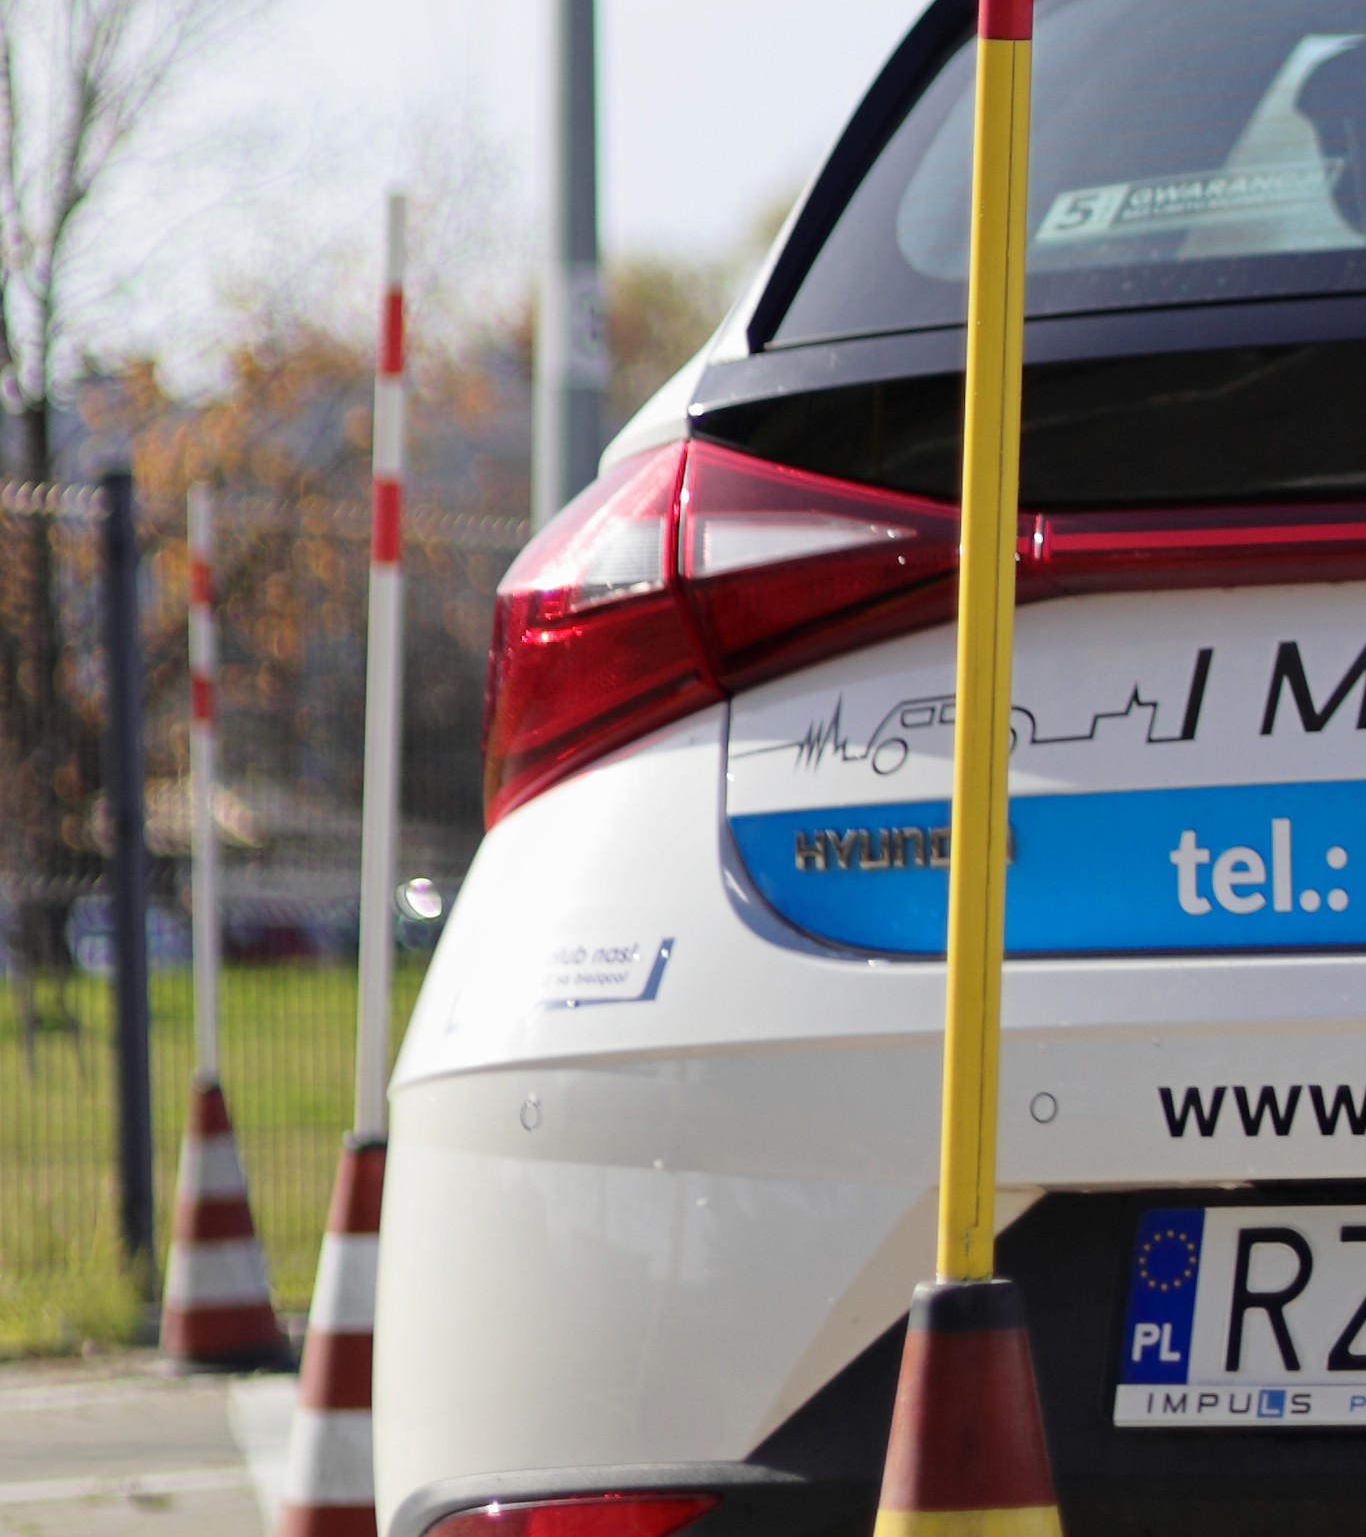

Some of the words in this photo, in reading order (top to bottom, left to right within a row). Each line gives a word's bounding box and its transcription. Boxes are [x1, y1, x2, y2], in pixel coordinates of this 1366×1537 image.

[794, 825, 1013, 873] HYUND
[1170, 817, 1349, 914] tel.:
[1131, 1322, 1182, 1364] PL
[1147, 1390, 1313, 1418] IMPULS
